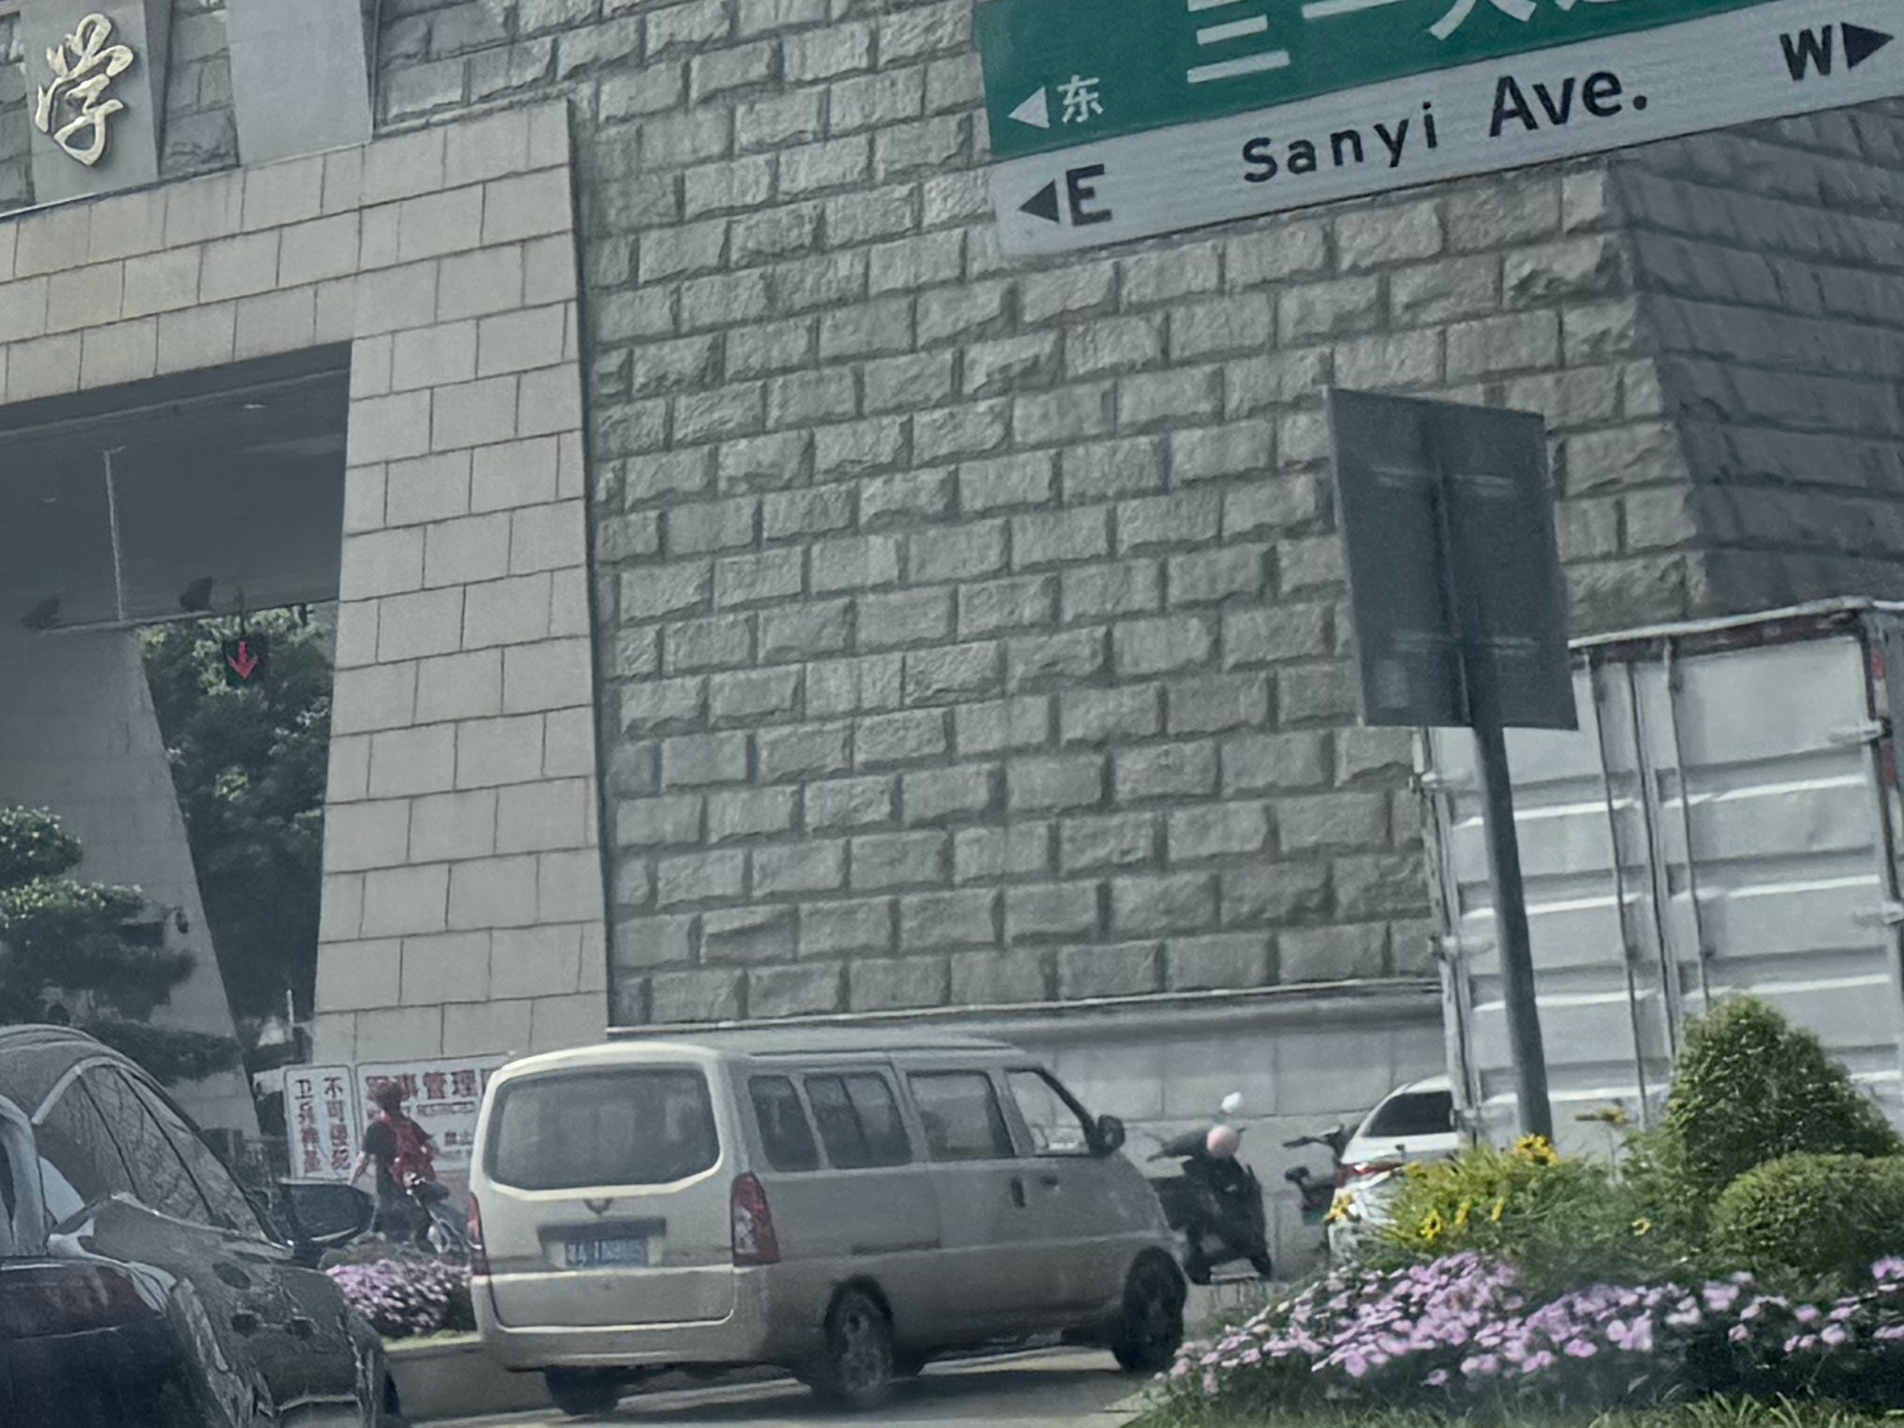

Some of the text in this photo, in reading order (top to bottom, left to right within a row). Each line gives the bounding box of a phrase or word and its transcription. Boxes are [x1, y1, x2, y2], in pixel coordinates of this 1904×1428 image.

[1056, 74, 1105, 124] 东
[1066, 24, 1833, 227] E Sanyi Ave. W
